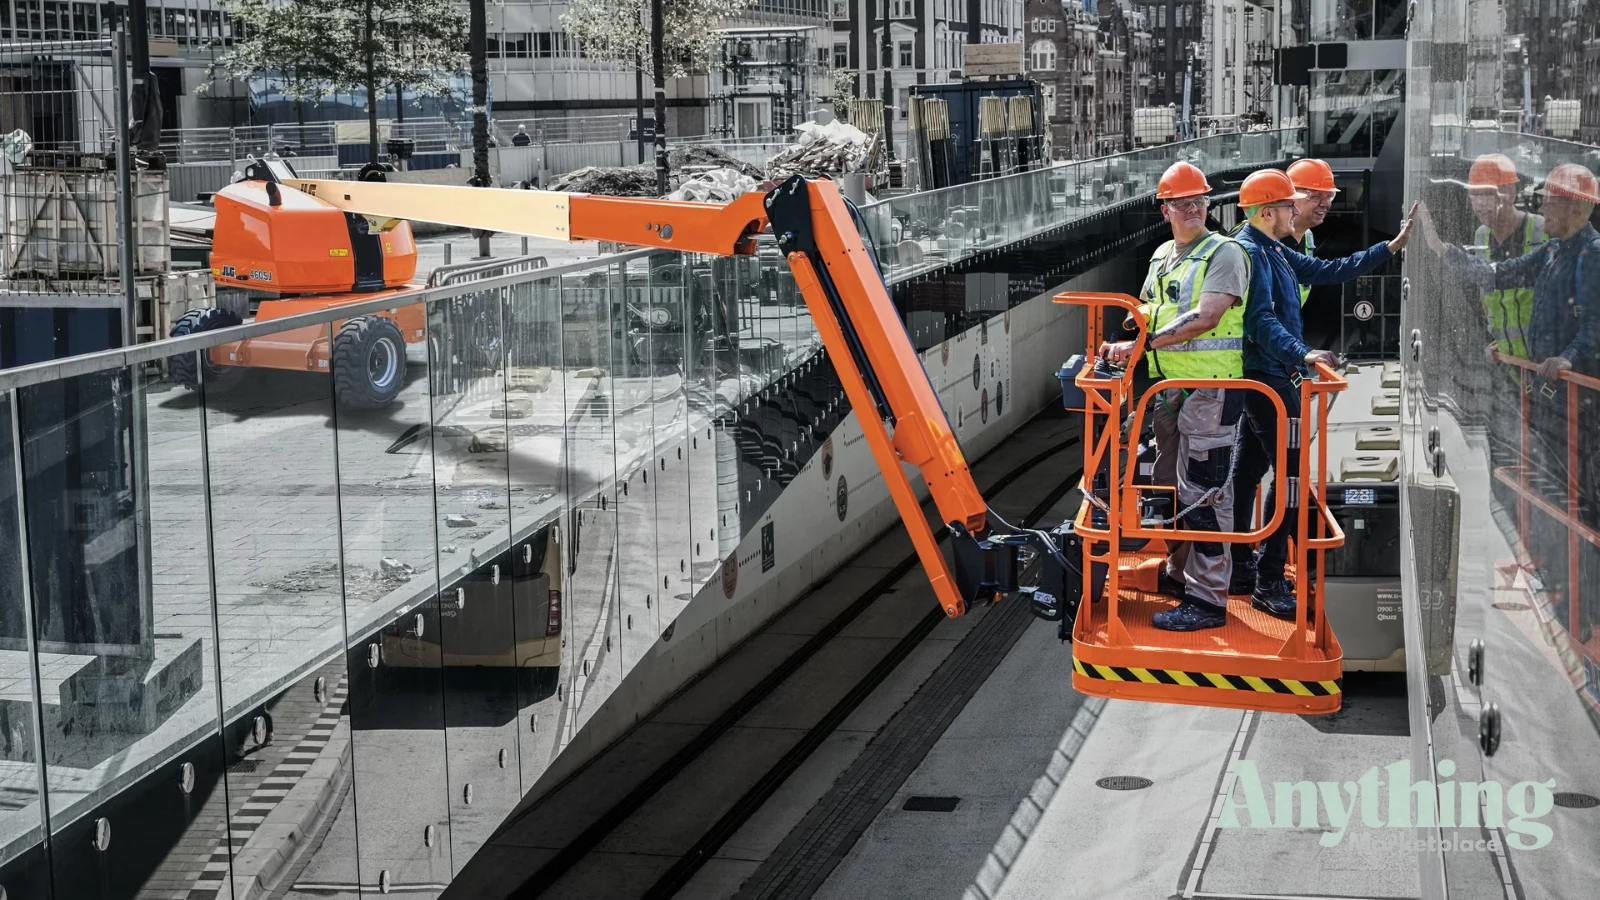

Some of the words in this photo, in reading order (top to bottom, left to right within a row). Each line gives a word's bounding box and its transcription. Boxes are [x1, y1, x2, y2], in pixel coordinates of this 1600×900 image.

[222, 264, 236, 279] JLG
[250, 269, 273, 282] 460SJ
[1377, 613, 1398, 621] Qbuzz
